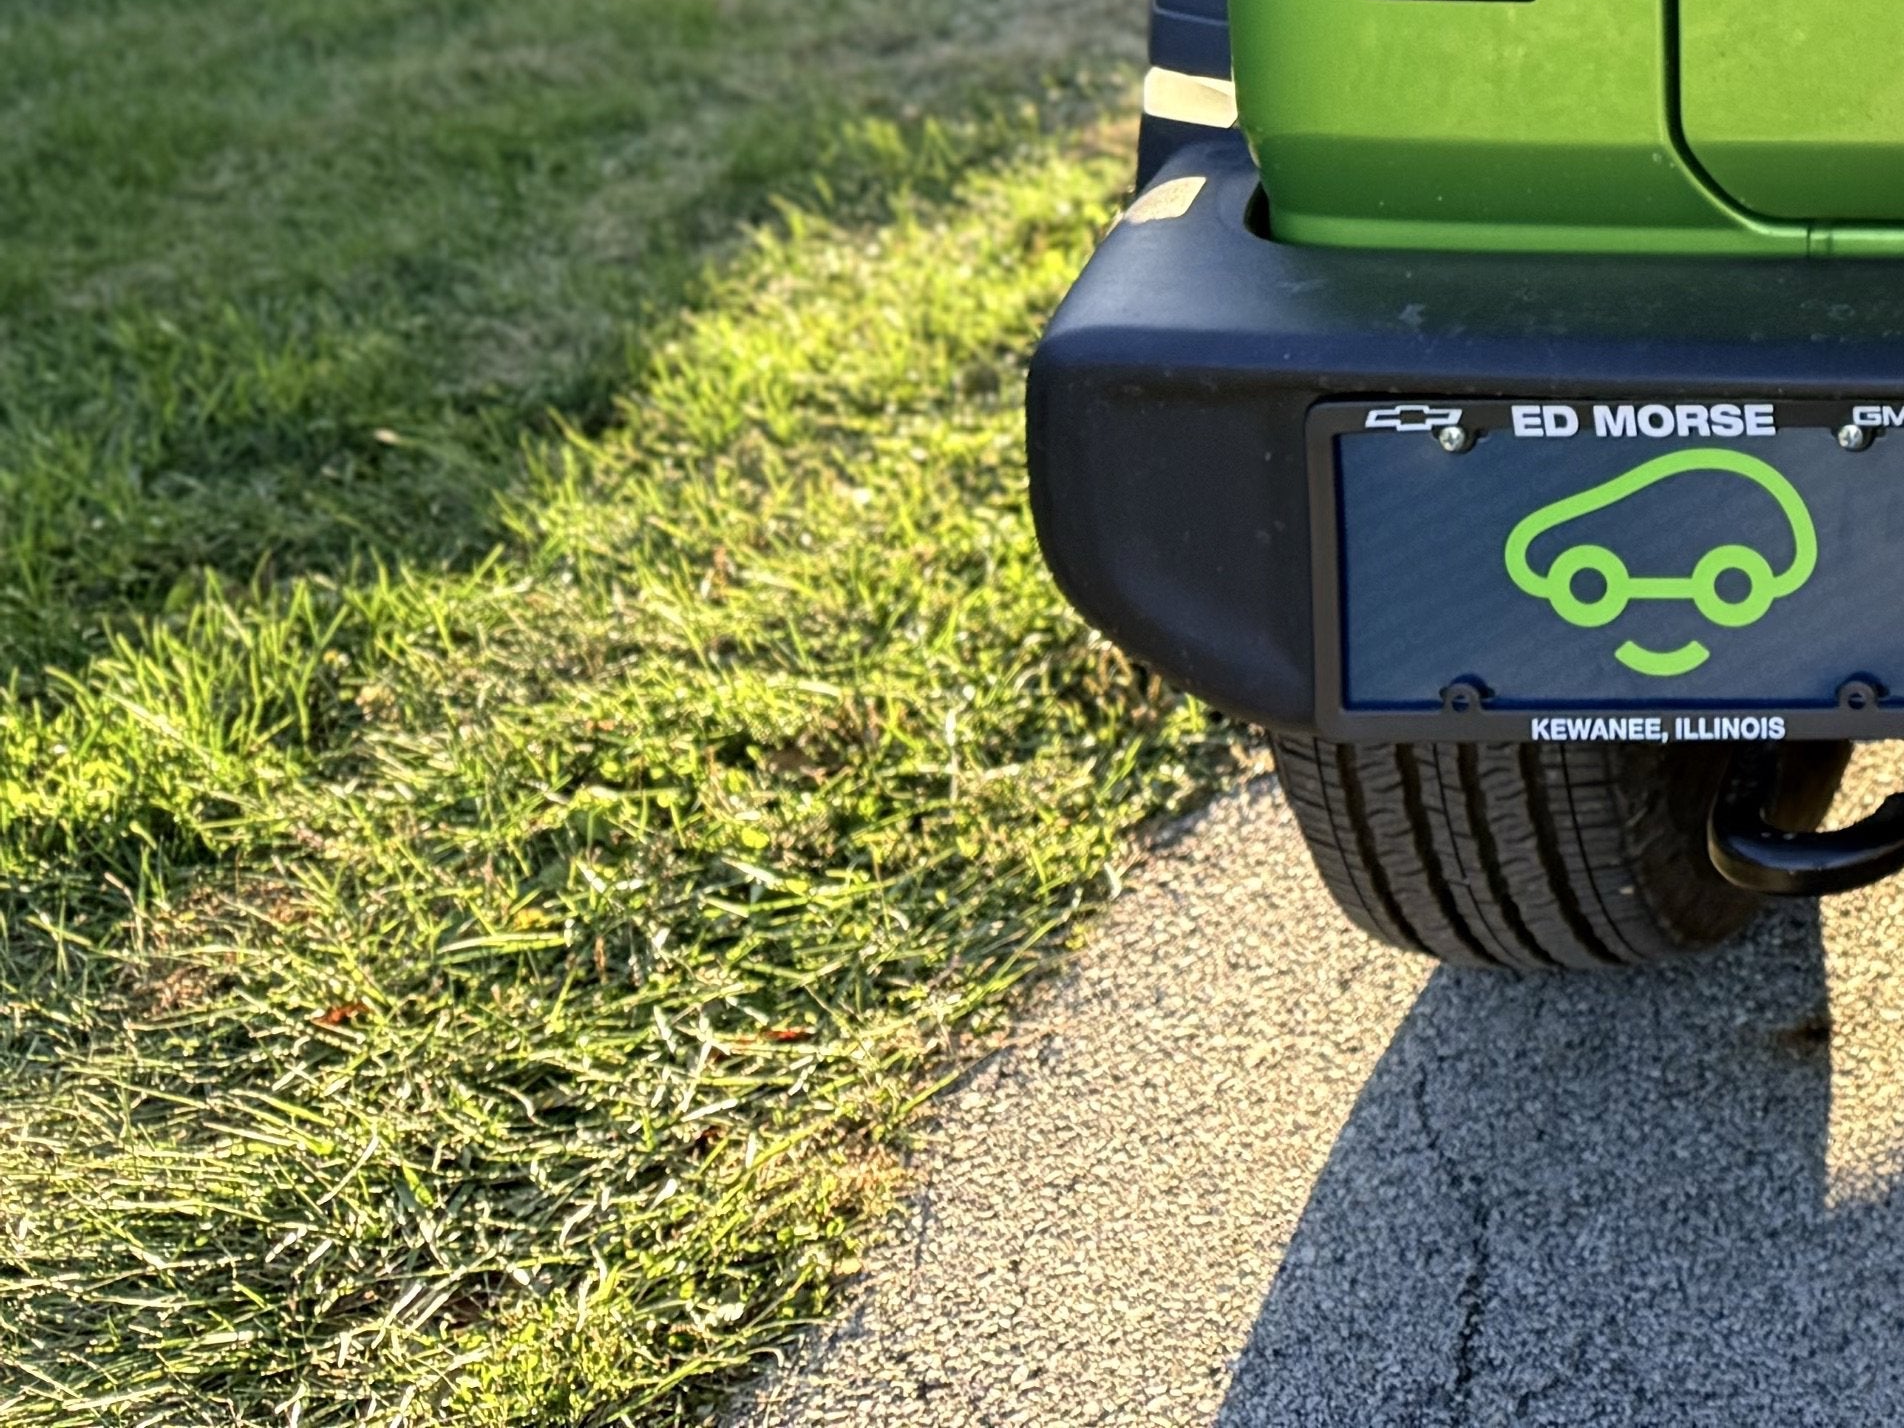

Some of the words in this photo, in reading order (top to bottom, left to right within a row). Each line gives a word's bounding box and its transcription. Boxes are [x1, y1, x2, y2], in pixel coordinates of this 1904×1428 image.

[1511, 404, 1579, 438] ED
[1592, 403, 1777, 437] MORSE
[1531, 717, 1669, 744] KEWANEE,
[1675, 716, 1786, 741] ILLINOIS
